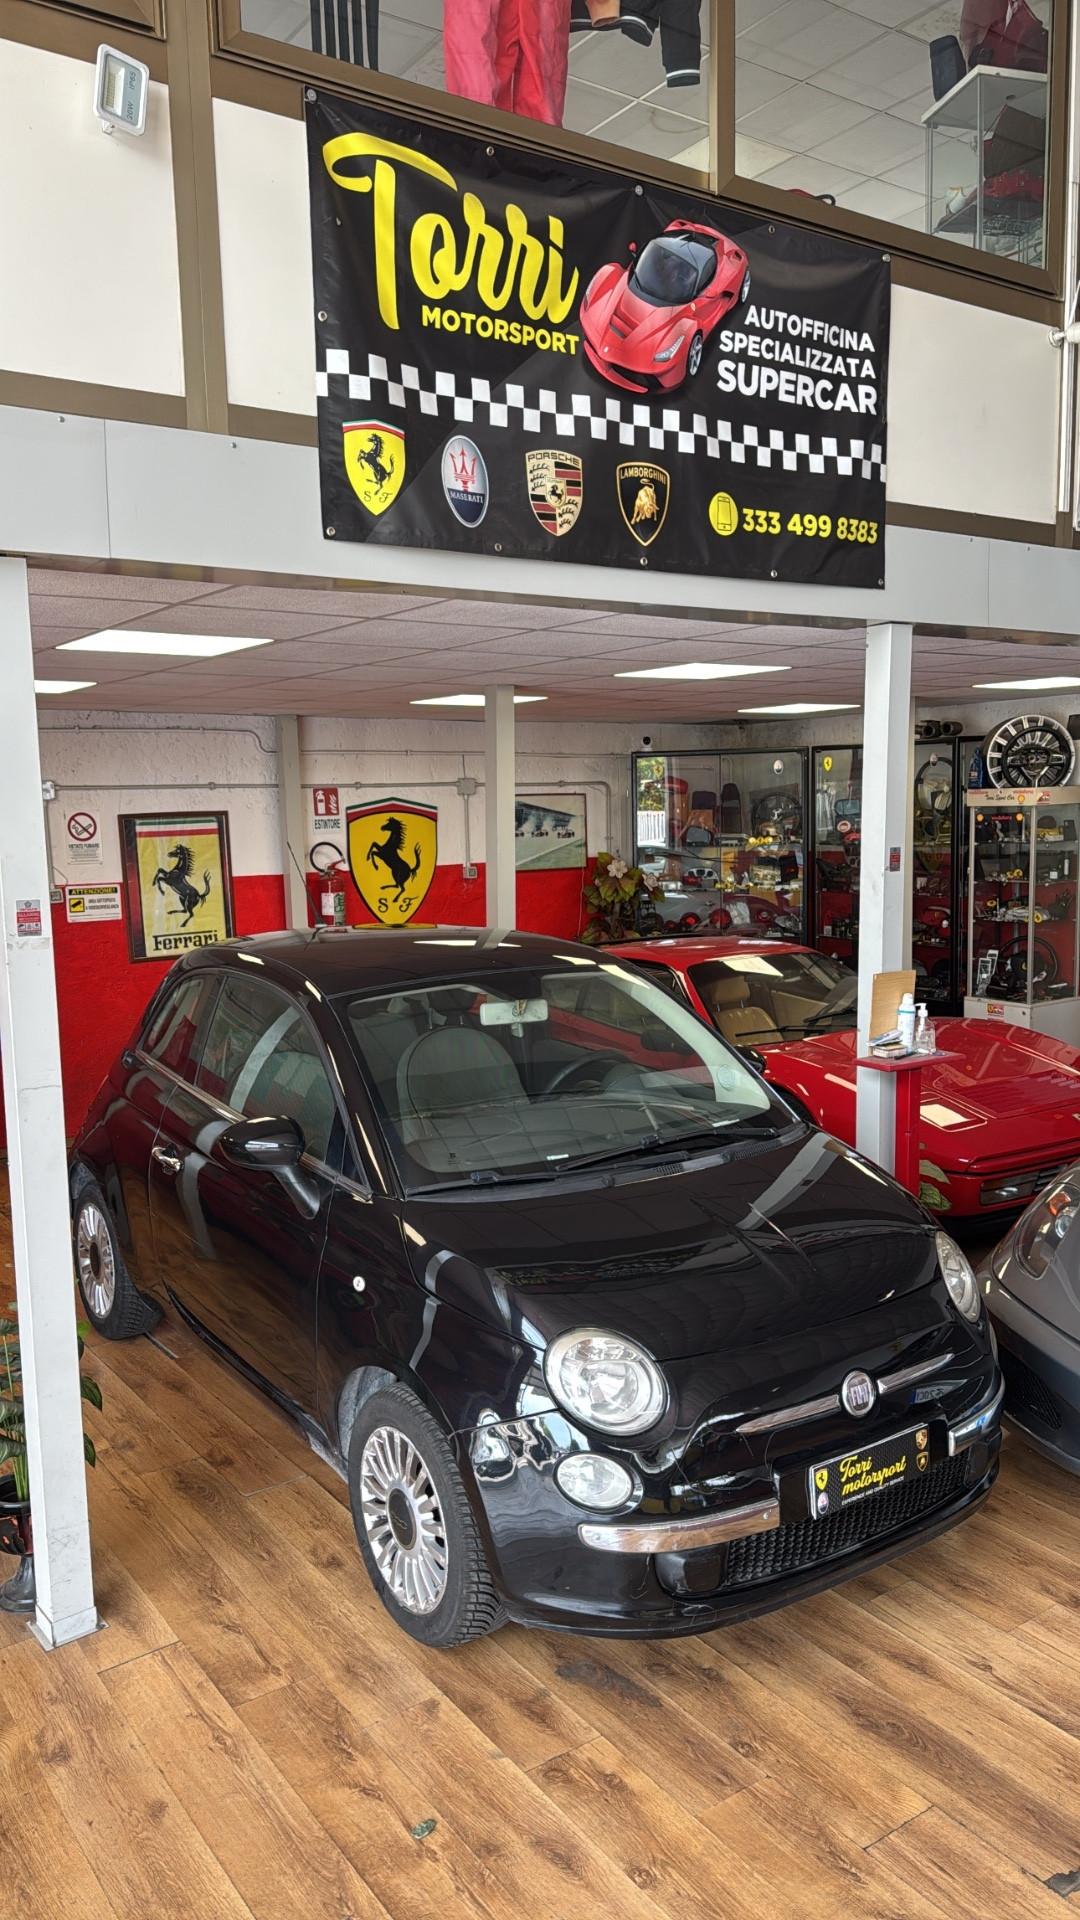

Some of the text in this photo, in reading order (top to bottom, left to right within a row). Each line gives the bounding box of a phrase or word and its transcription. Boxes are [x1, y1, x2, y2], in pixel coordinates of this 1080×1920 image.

[322, 132, 579, 330] Torri
[421, 304, 580, 355] MOTORSPORT
[744, 304, 876, 353] AUTOFFICINA
[719, 330, 877, 379] SPECIALIZZATA
[716, 359, 878, 416] SUPERCAR
[527, 452, 581, 466] PORSCHE
[620, 468, 667, 486] LAMBORGHINI
[363, 489, 372, 502] S
[449, 490, 484, 504] MASERATI
[742, 507, 879, 544] 333 499 8383
[314, 818, 341, 830] ESTINTORE
[71, 886, 117, 896] ATTENZIONE!
[378, 897, 389, 913] S
[152, 929, 218, 951] Ferrari
[850, 1382, 869, 1407] FIAT
[840, 1455, 872, 1482] Torri
[842, 1455, 907, 1496] motorsport
